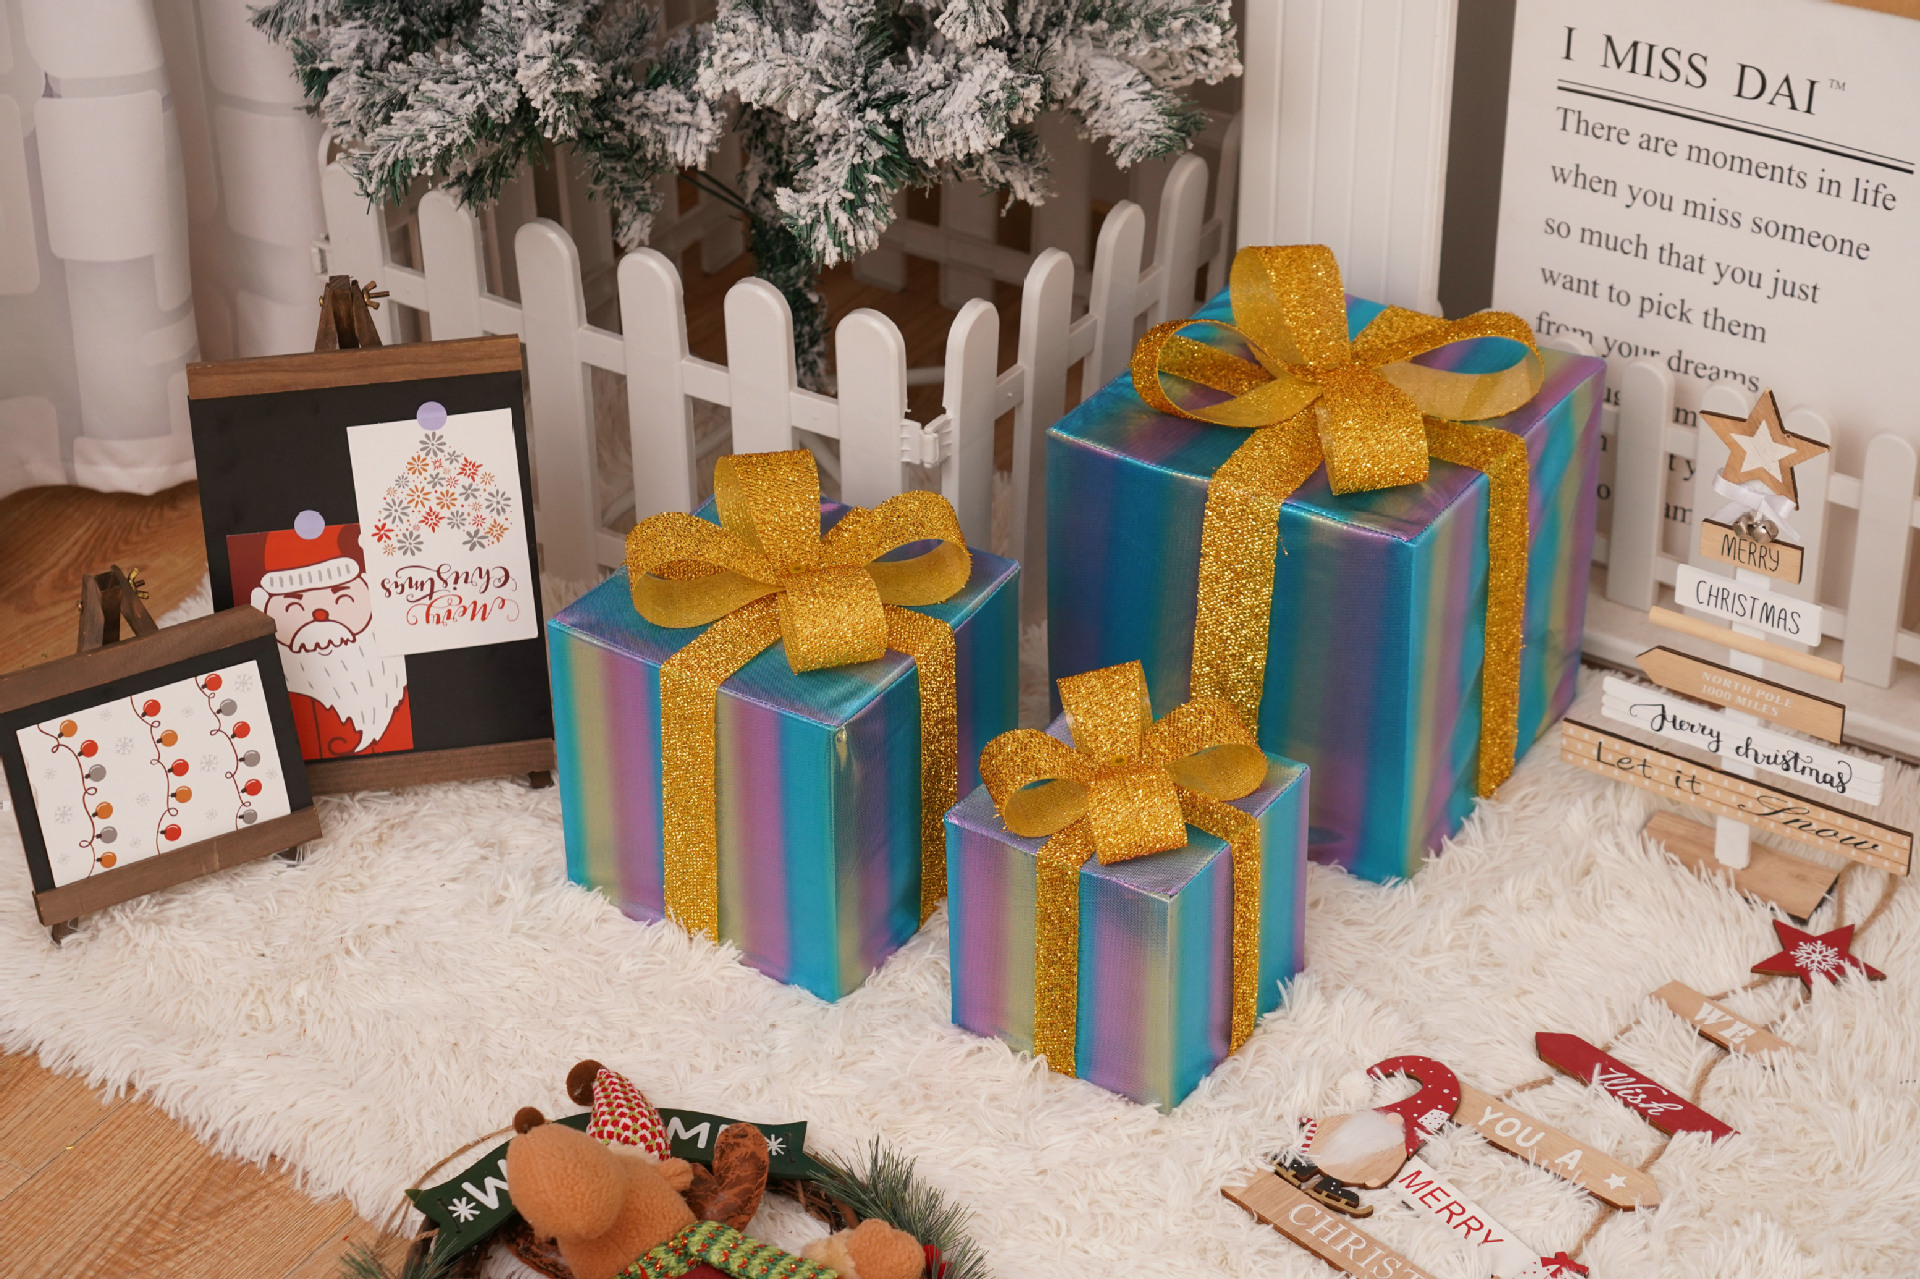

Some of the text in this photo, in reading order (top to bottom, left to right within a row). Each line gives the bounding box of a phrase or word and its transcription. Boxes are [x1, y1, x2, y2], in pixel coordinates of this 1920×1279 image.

[1561, 25, 1577, 61] I
[1600, 34, 1708, 89] MISS
[1734, 62, 1819, 115] DAI
[1556, 106, 1897, 212] There are moments in life
[1551, 163, 1871, 261] when you miss someone
[1544, 216, 1820, 304] so much that you just
[1540, 267, 1767, 343] want to pick them
[1667, 349, 1760, 393] dreams
[1721, 533, 1780, 572] MERRY
[381, 563, 517, 602] Christmas
[1695, 580, 1801, 635] CHRISTMAS
[406, 594, 520, 626] Merry
[1701, 684, 1779, 716] 1000 MILES
[1702, 671, 1792, 708] NORTH POLE
[1629, 704, 1723, 753] Merry
[1596, 741, 1879, 851] Let it Snow
[1694, 1001, 1757, 1044] WE
[1599, 1067, 1683, 1115] Wish
[1478, 1106, 1583, 1170] YOU A
[1398, 1169, 1504, 1247] MERRY
